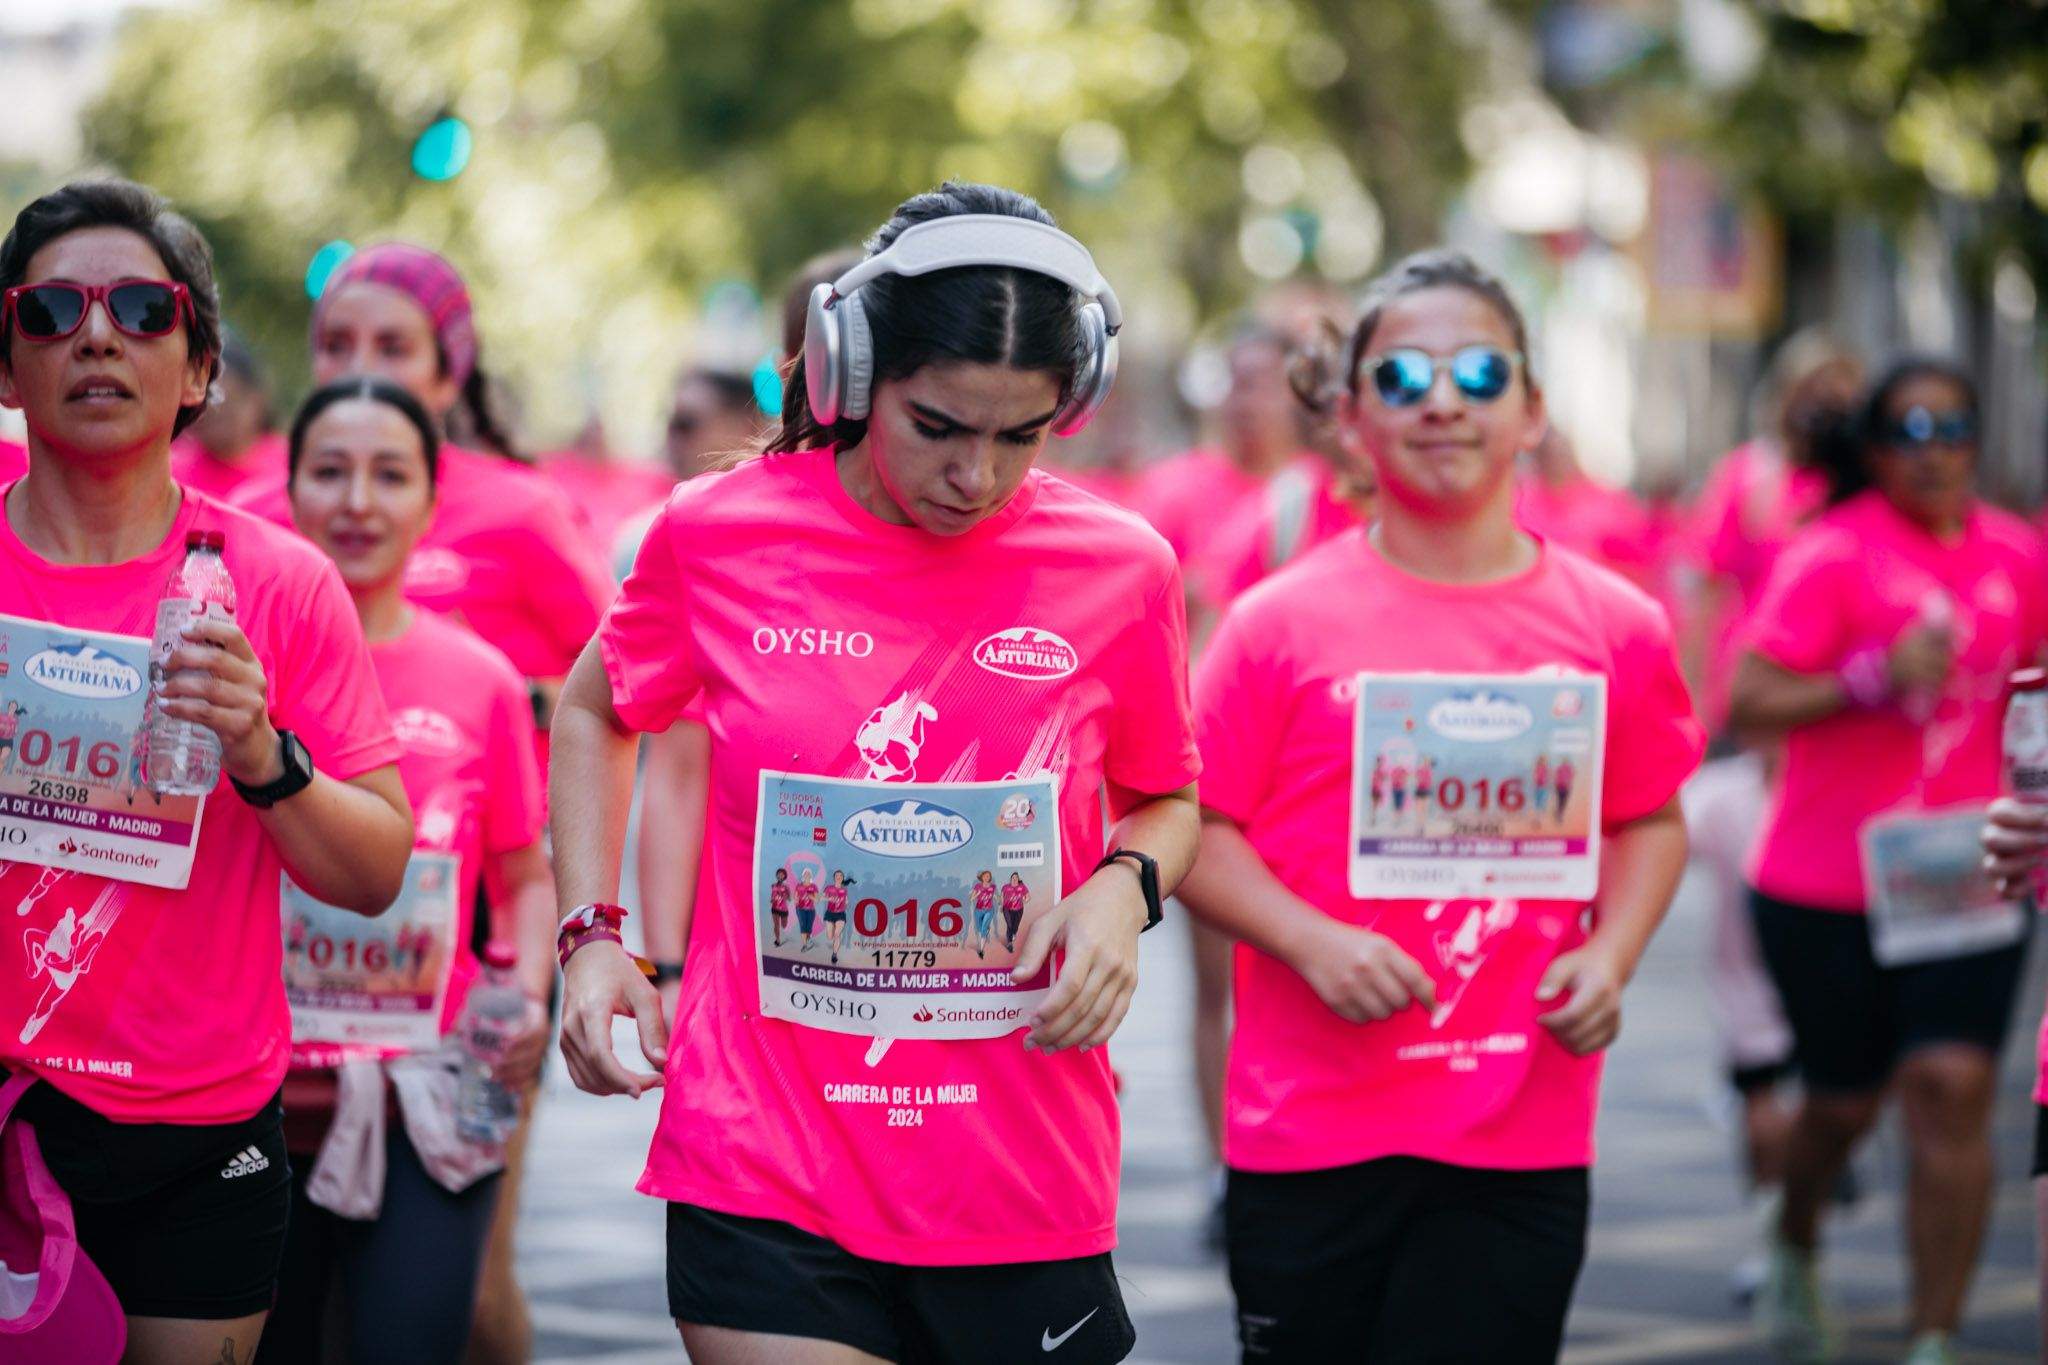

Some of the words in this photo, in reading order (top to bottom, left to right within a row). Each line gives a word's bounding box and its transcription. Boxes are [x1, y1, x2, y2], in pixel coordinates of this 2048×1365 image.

[753, 627, 874, 657] OYSHO
[982, 644, 1070, 671] ASTURIANA
[32, 658, 132, 691] ASTURIANA
[19, 728, 121, 779] 016
[28, 779, 89, 804] 26398
[1437, 776, 1526, 812] 016
[13, 798, 30, 814] DE
[33, 803, 49, 818] LA
[53, 807, 98, 825] MUJER
[109, 815, 162, 836] MADRID
[778, 802, 824, 819] SUMA
[1004, 799, 1030, 817] 20
[851, 820, 964, 843] ASTURIANA
[80, 842, 160, 869] Santander
[853, 898, 963, 937] 016
[308, 936, 387, 972] 016
[871, 950, 936, 968] 11779
[791, 964, 853, 985] CARRERA
[856, 973, 875, 987] DE
[879, 973, 898, 988] LA
[901, 974, 950, 988] MUJER
[790, 990, 877, 1021] OYSHO
[936, 1006, 1023, 1022] Santander
[68, 1060, 84, 1072] LA
[88, 1060, 133, 1077] MUJER
[823, 1083, 889, 1104] CARRERA
[892, 1086, 912, 1105] DE
[915, 1086, 934, 1105] LA
[937, 1084, 978, 1104] MUJER
[887, 1107, 924, 1127] 2024
[220, 1157, 270, 1179] adidas
